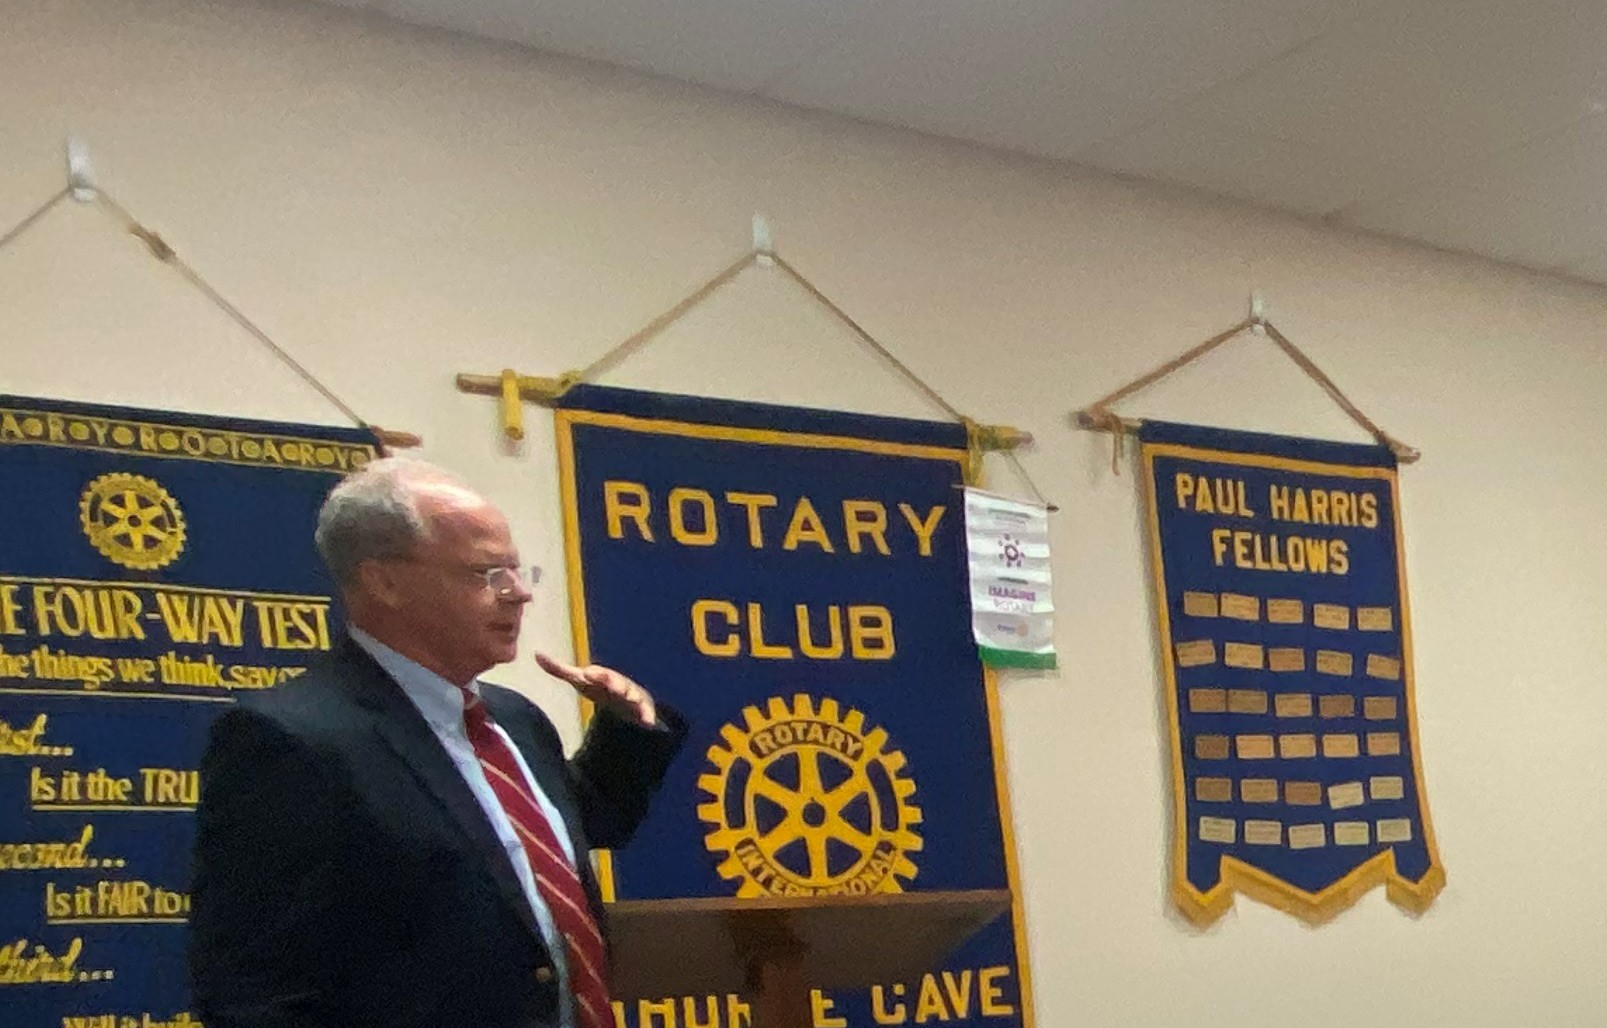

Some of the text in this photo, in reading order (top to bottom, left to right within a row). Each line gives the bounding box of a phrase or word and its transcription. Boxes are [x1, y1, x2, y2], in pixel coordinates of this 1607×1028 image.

[604, 480, 947, 556] ROTARY
[1175, 472, 1379, 529] PAUL HARRIS
[1212, 529, 1350, 575] FELLOWS
[33, 585, 245, 648] FOUR-WAY
[251, 600, 331, 650] TEST
[691, 599, 897, 661] CLUB
[31, 643, 115, 690] things
[117, 656, 155, 683] we
[752, 720, 863, 758] ROTARY
[31, 767, 56, 802] Is
[61, 770, 81, 802] it
[87, 768, 133, 802] the
[47, 882, 71, 917] Is
[75, 886, 92, 915] it
[97, 881, 151, 916] FAIR
[871, 967, 1015, 1026] CAVE
